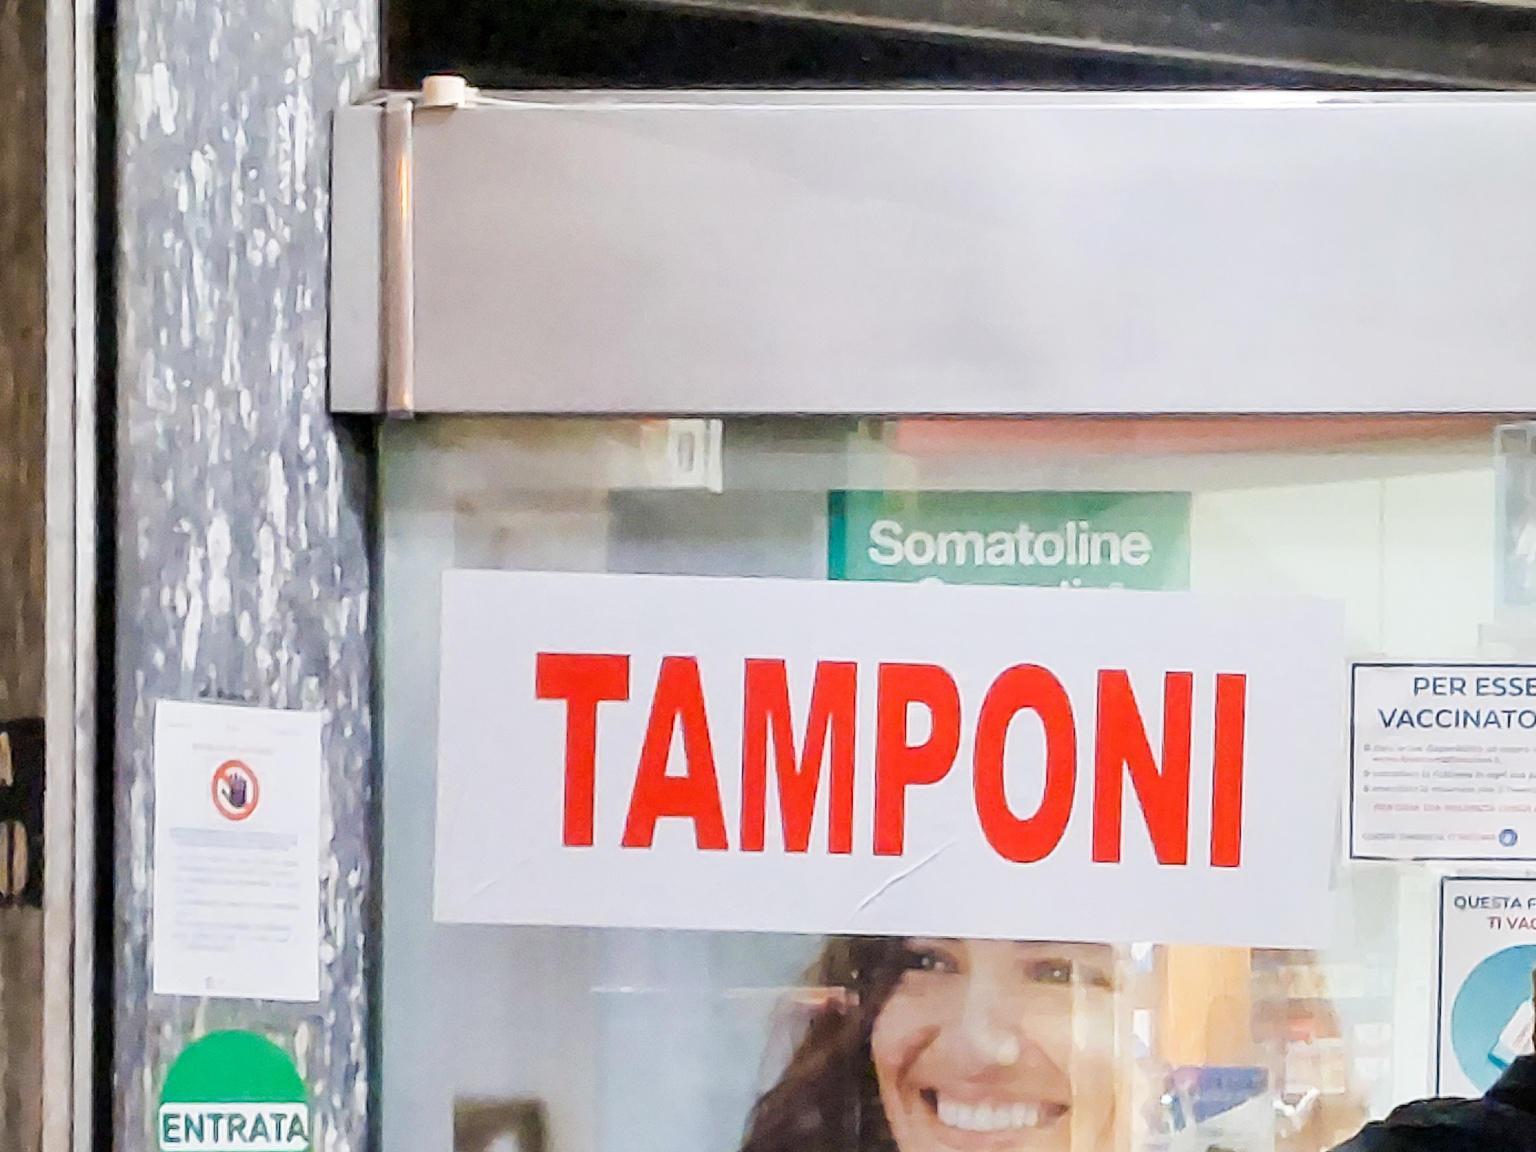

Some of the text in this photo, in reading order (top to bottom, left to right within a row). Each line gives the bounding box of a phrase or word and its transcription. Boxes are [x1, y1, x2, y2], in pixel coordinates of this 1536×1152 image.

[868, 519, 1153, 566] Somatoline
[1413, 677, 1466, 697] PER
[536, 652, 1247, 868] TAMPONI
[1454, 896, 1523, 910] QUESTA
[1487, 916, 1501, 930] TI
[162, 1112, 308, 1144] ENTRATA
